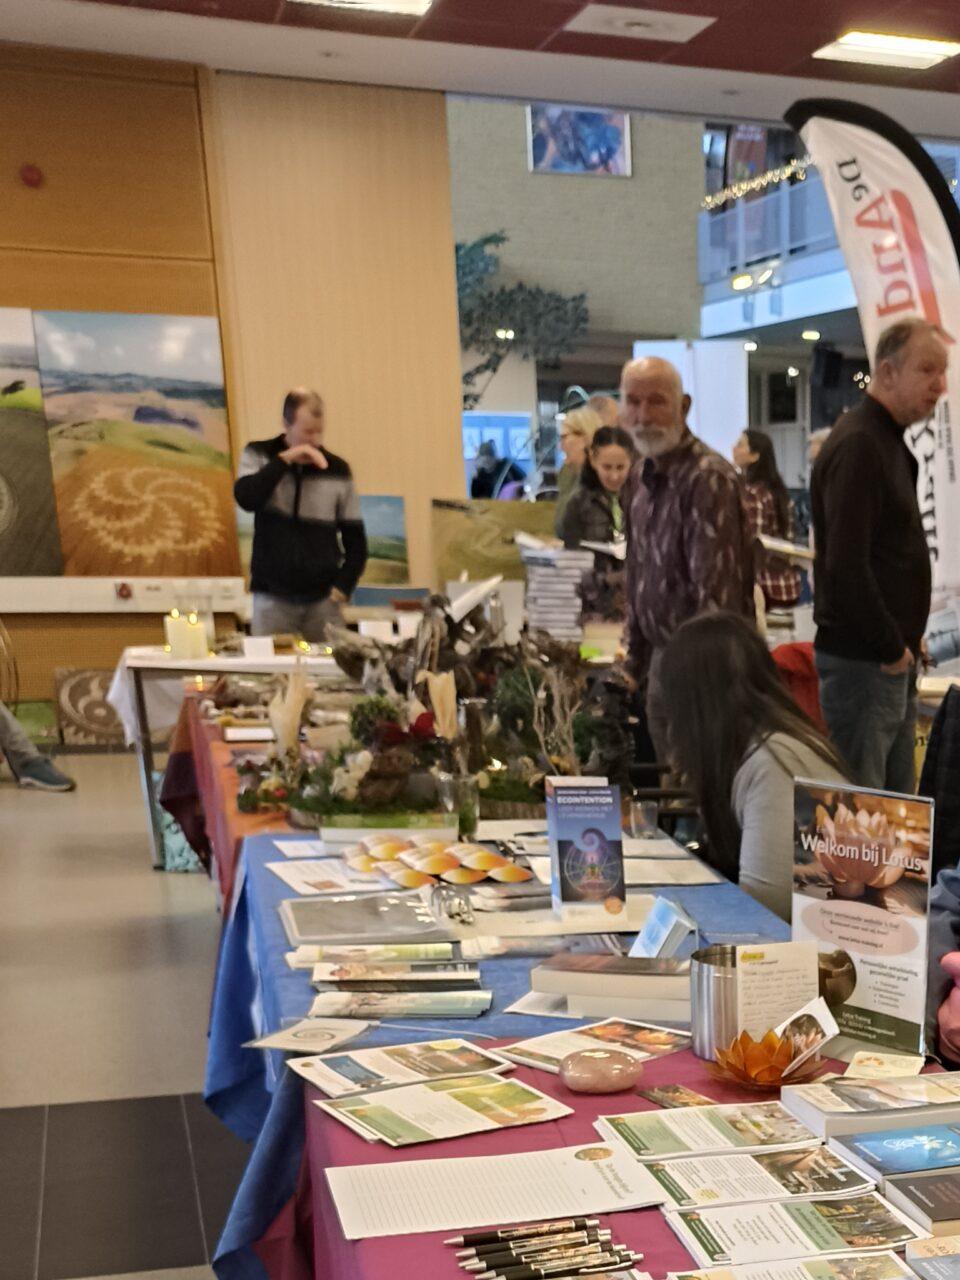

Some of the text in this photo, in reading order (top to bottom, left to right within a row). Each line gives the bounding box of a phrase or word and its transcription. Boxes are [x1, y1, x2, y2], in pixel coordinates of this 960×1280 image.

[800, 833, 922, 871] Welkom bij Lotus
